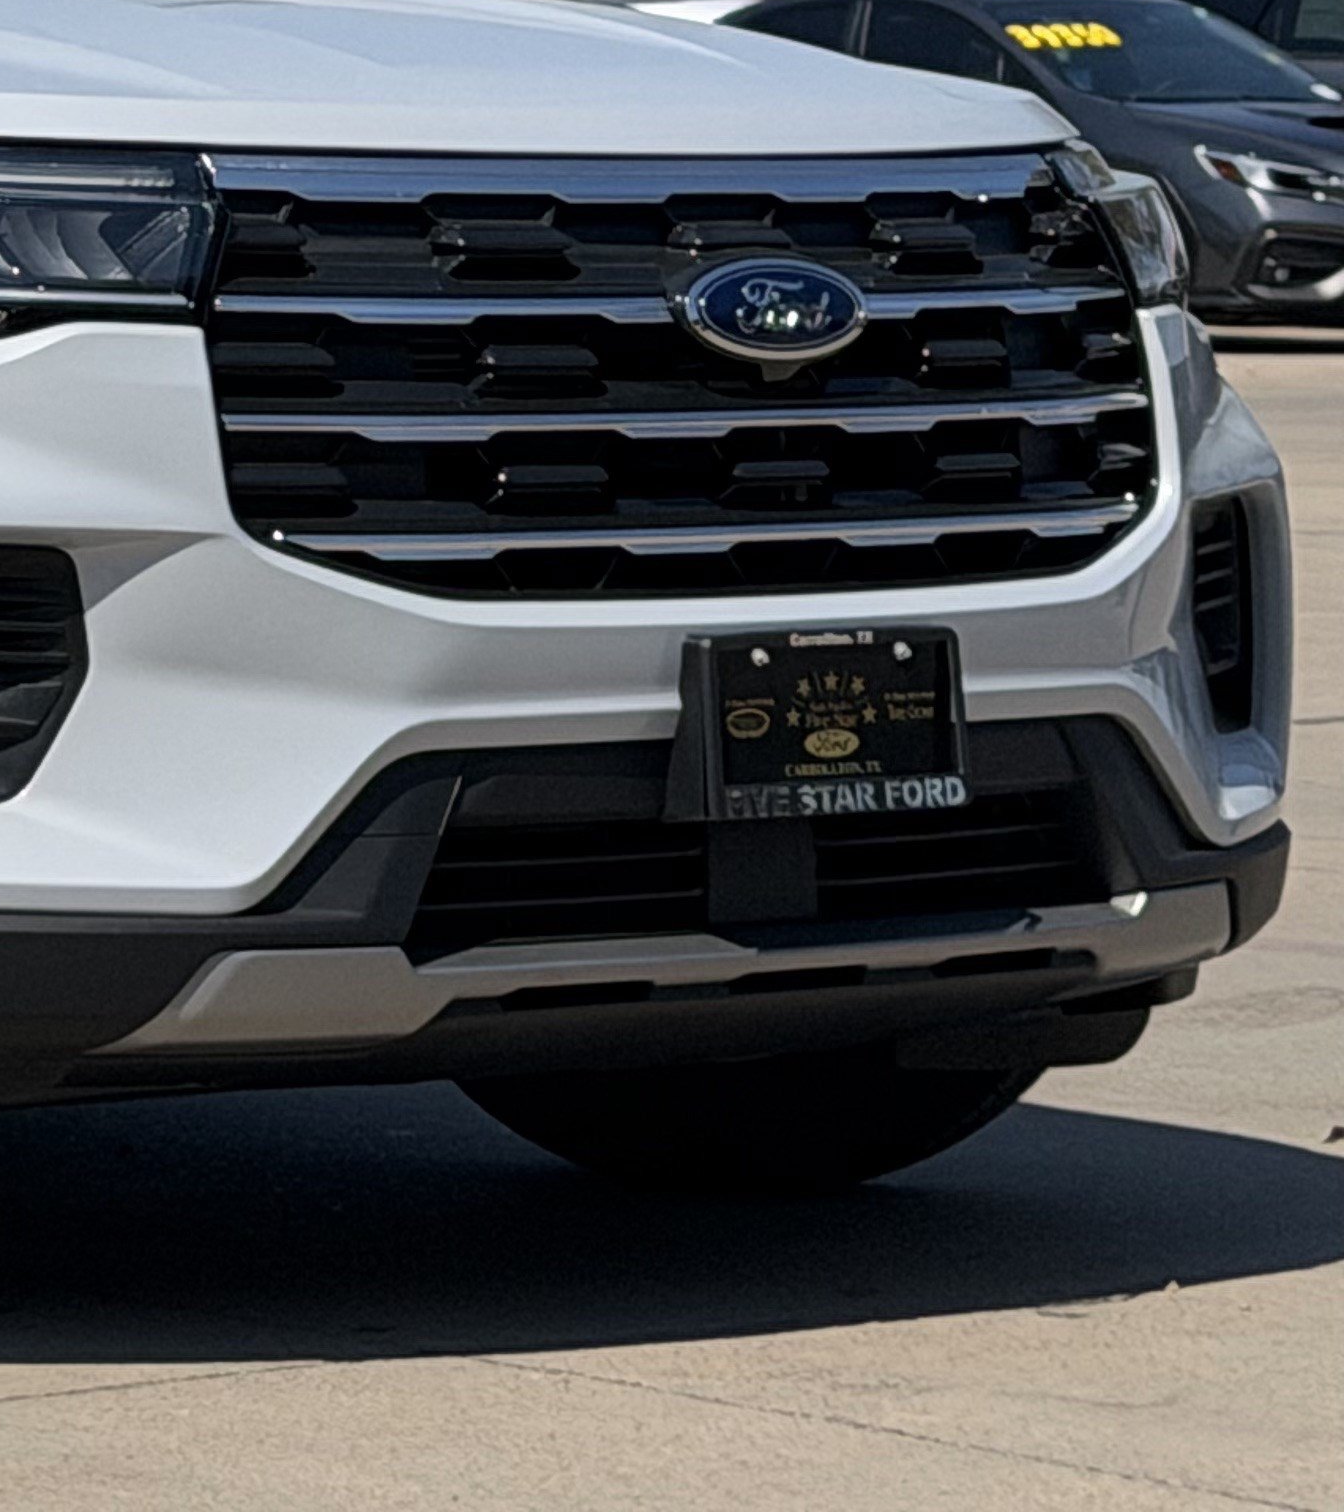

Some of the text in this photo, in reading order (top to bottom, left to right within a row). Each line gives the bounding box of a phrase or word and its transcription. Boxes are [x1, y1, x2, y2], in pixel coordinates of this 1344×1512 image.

[735, 277, 833, 334] Ford
[796, 780, 878, 816] STAR
[884, 775, 967, 810] FORD
